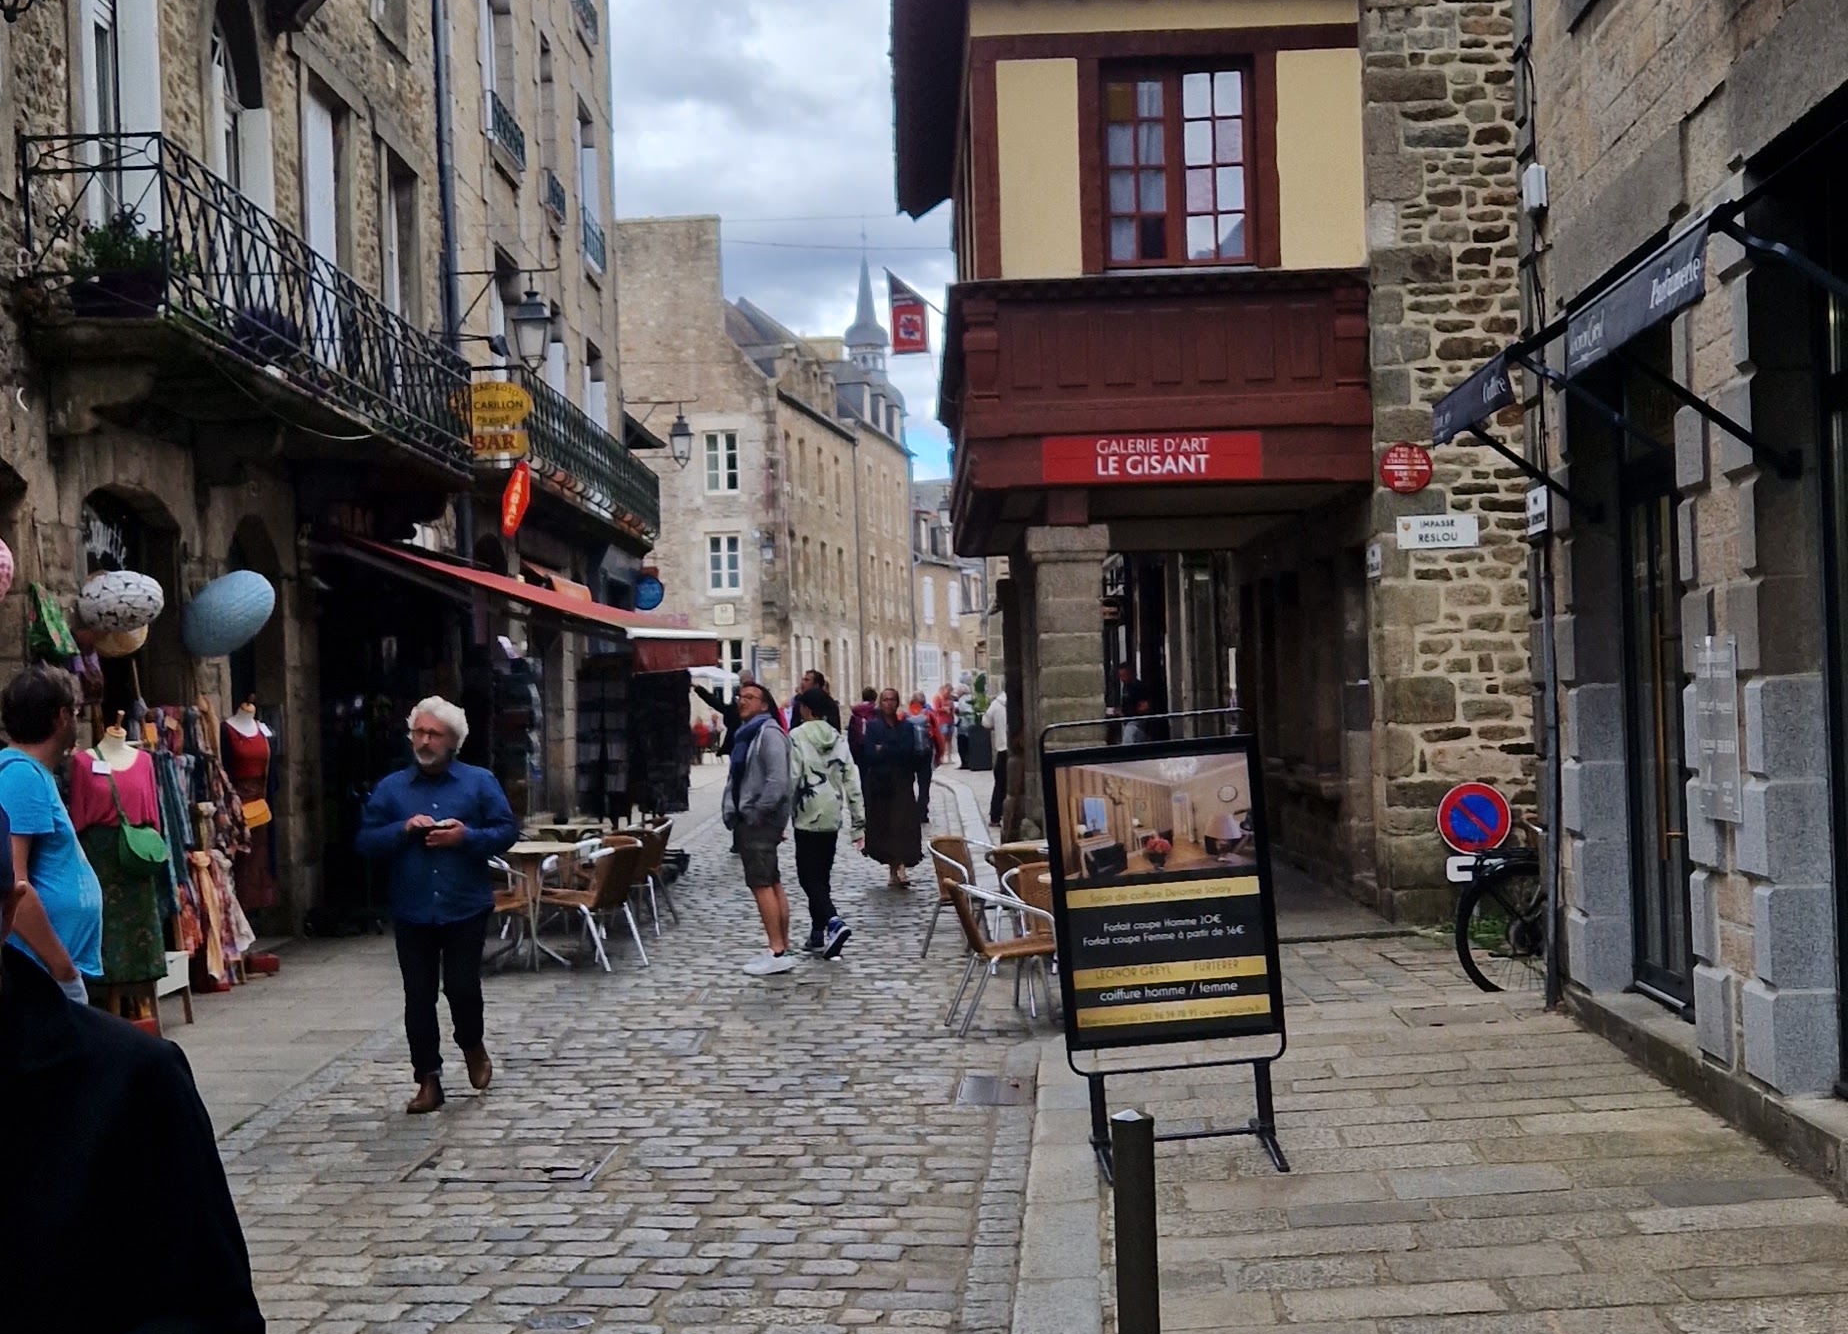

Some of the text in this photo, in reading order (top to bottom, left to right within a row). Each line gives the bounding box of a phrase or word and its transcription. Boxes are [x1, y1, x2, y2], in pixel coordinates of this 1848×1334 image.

[474, 400, 524, 410] CARILLON
[474, 434, 518, 451] BAR
[1096, 437, 1210, 455] GALERIE D'ART
[1096, 454, 1210, 476] LE GISANT
[504, 470, 526, 527] TABAC
[1420, 519, 1456, 528] IMPASSE
[1418, 532, 1458, 543] RESLOU
[1103, 921, 1131, 933] Forfait
[1133, 920, 1162, 931] coupe
[1164, 917, 1197, 927] Homme
[1083, 936, 1110, 947] Forfait
[1112, 935, 1141, 946] coupe
[1143, 931, 1176, 942] Femme
[1211, 927, 1224, 937] de
[1100, 988, 1142, 1002] coiffure
[1144, 985, 1186, 998] homme
[1199, 981, 1239, 993] femme
